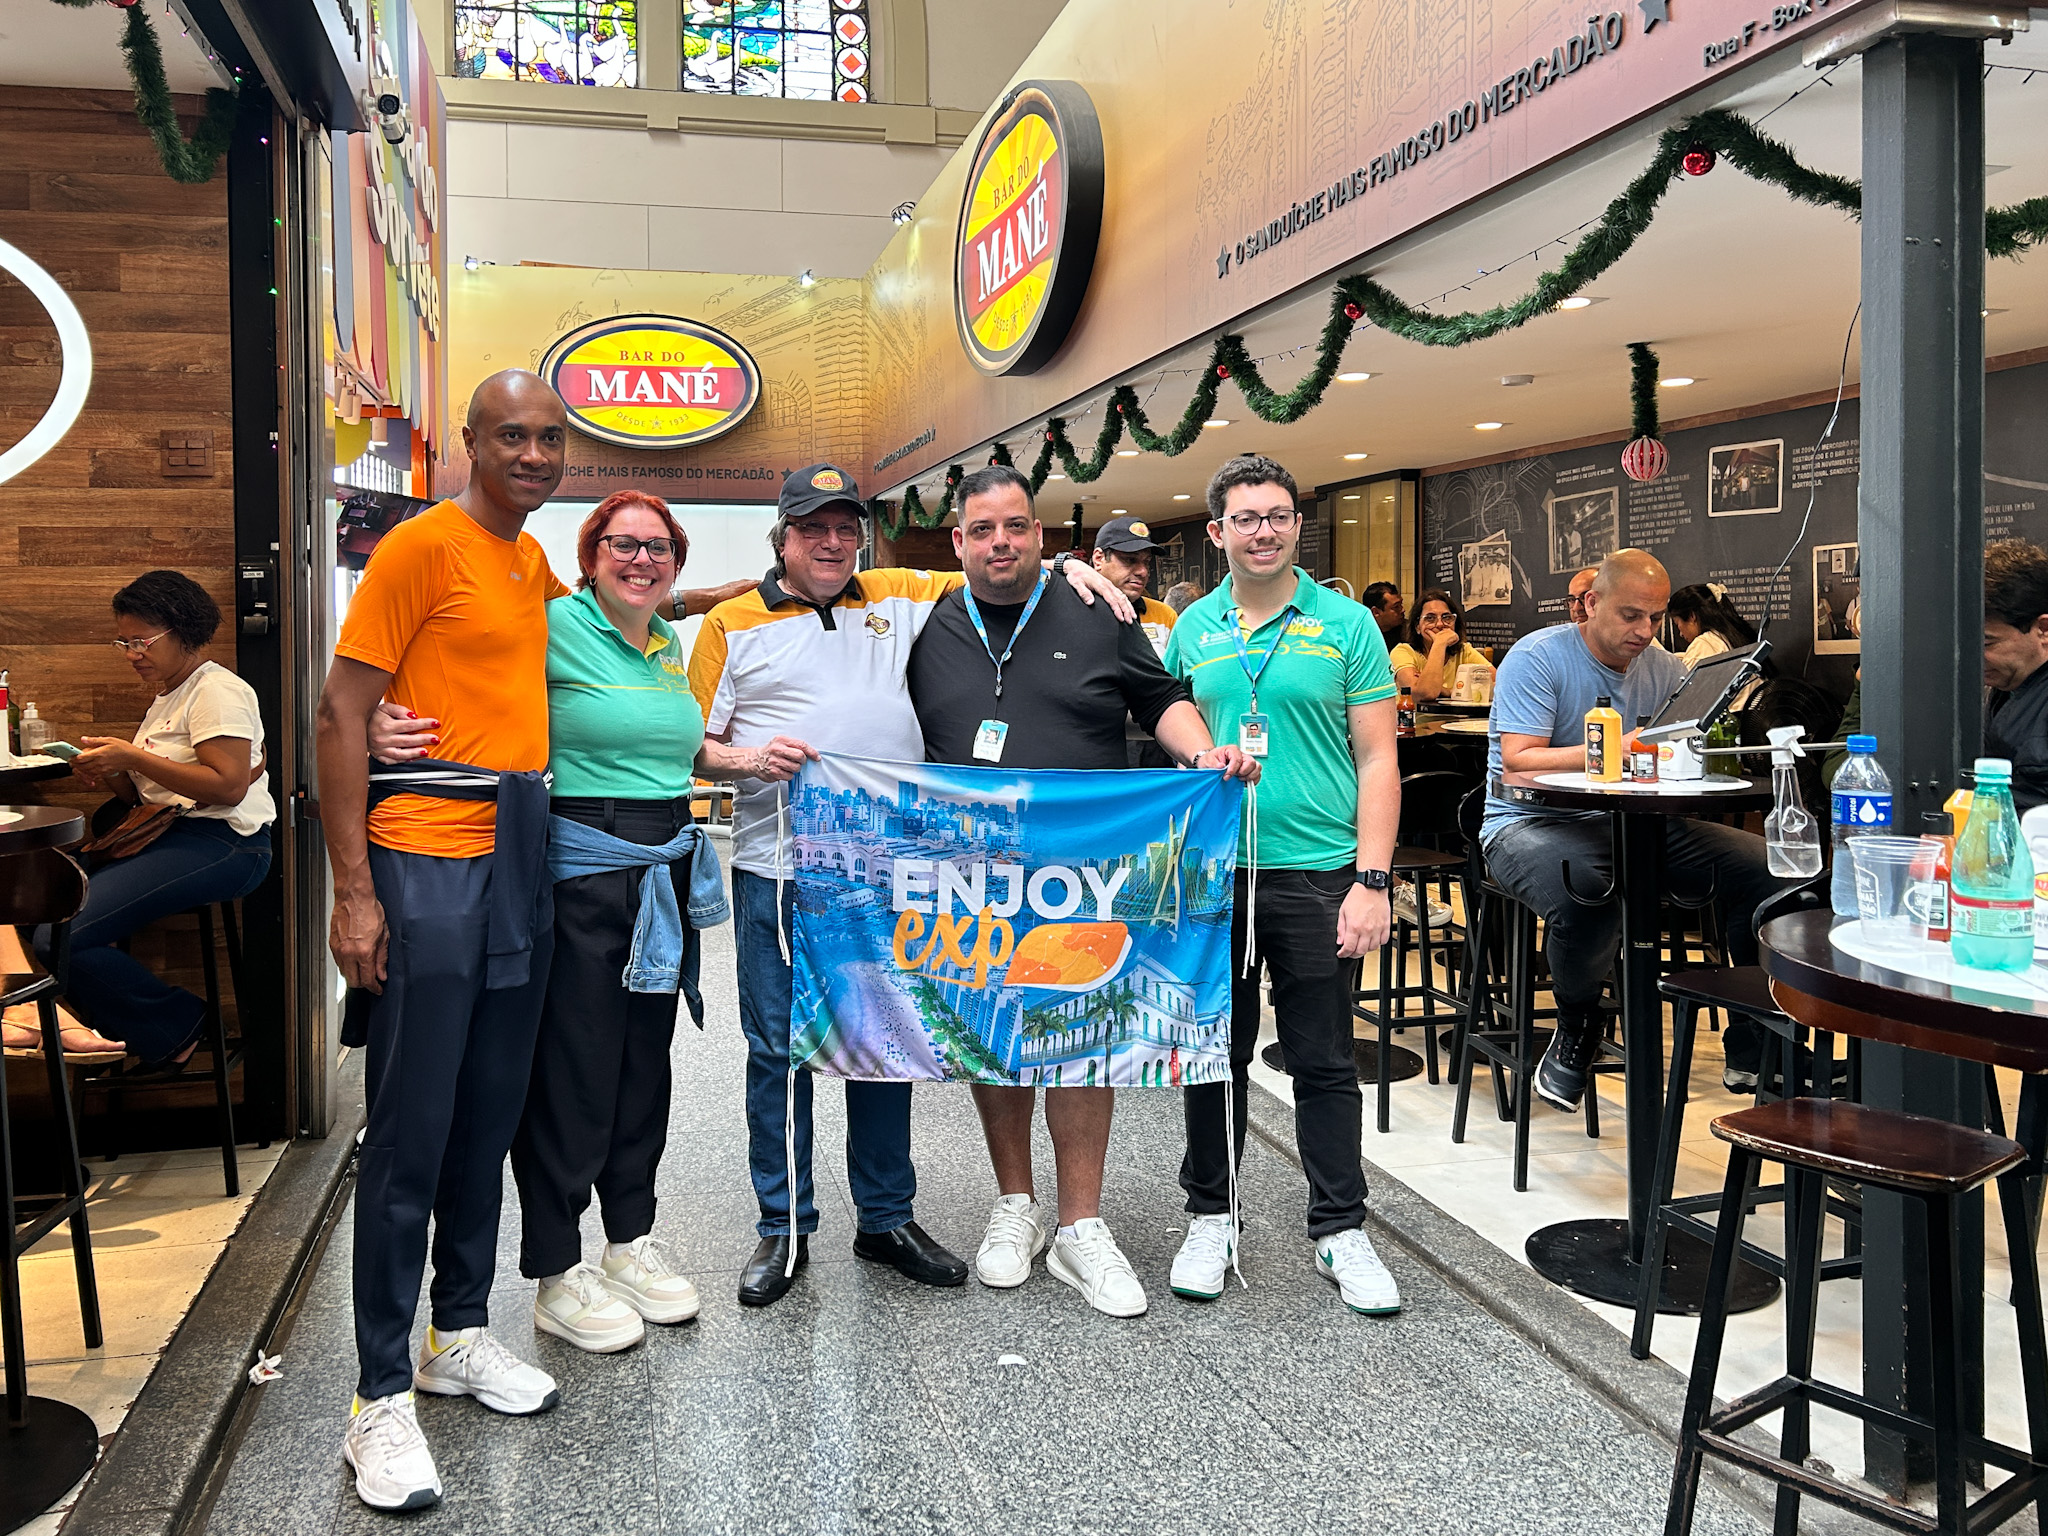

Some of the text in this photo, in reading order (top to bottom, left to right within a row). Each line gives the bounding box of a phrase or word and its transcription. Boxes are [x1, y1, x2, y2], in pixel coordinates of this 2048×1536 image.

[1703, 42, 1739, 67] Rua
[1742, 21, 1756, 46] F
[1772, 0, 1812, 30] Box
[1235, 11, 1625, 266] O SANDUÍCHE MAIS FAMOSO DO MERCADÃO
[993, 156, 1030, 210] BAR DO
[366, 120, 440, 342] Sorvete
[977, 159, 1049, 304] MANÉ
[619, 350, 685, 362] BAR DO
[586, 361, 720, 404] MANÉ
[616, 411, 690, 428] DESDE 1933
[598, 466, 629, 478] MAIS
[632, 467, 683, 478] FAMOSO
[686, 468, 702, 479] DO
[706, 467, 774, 480] MERCADÃO
[1289, 616, 1322, 627] NJOY
[1849, 797, 1858, 822] crystal
[892, 859, 1132, 921] ENJOY
